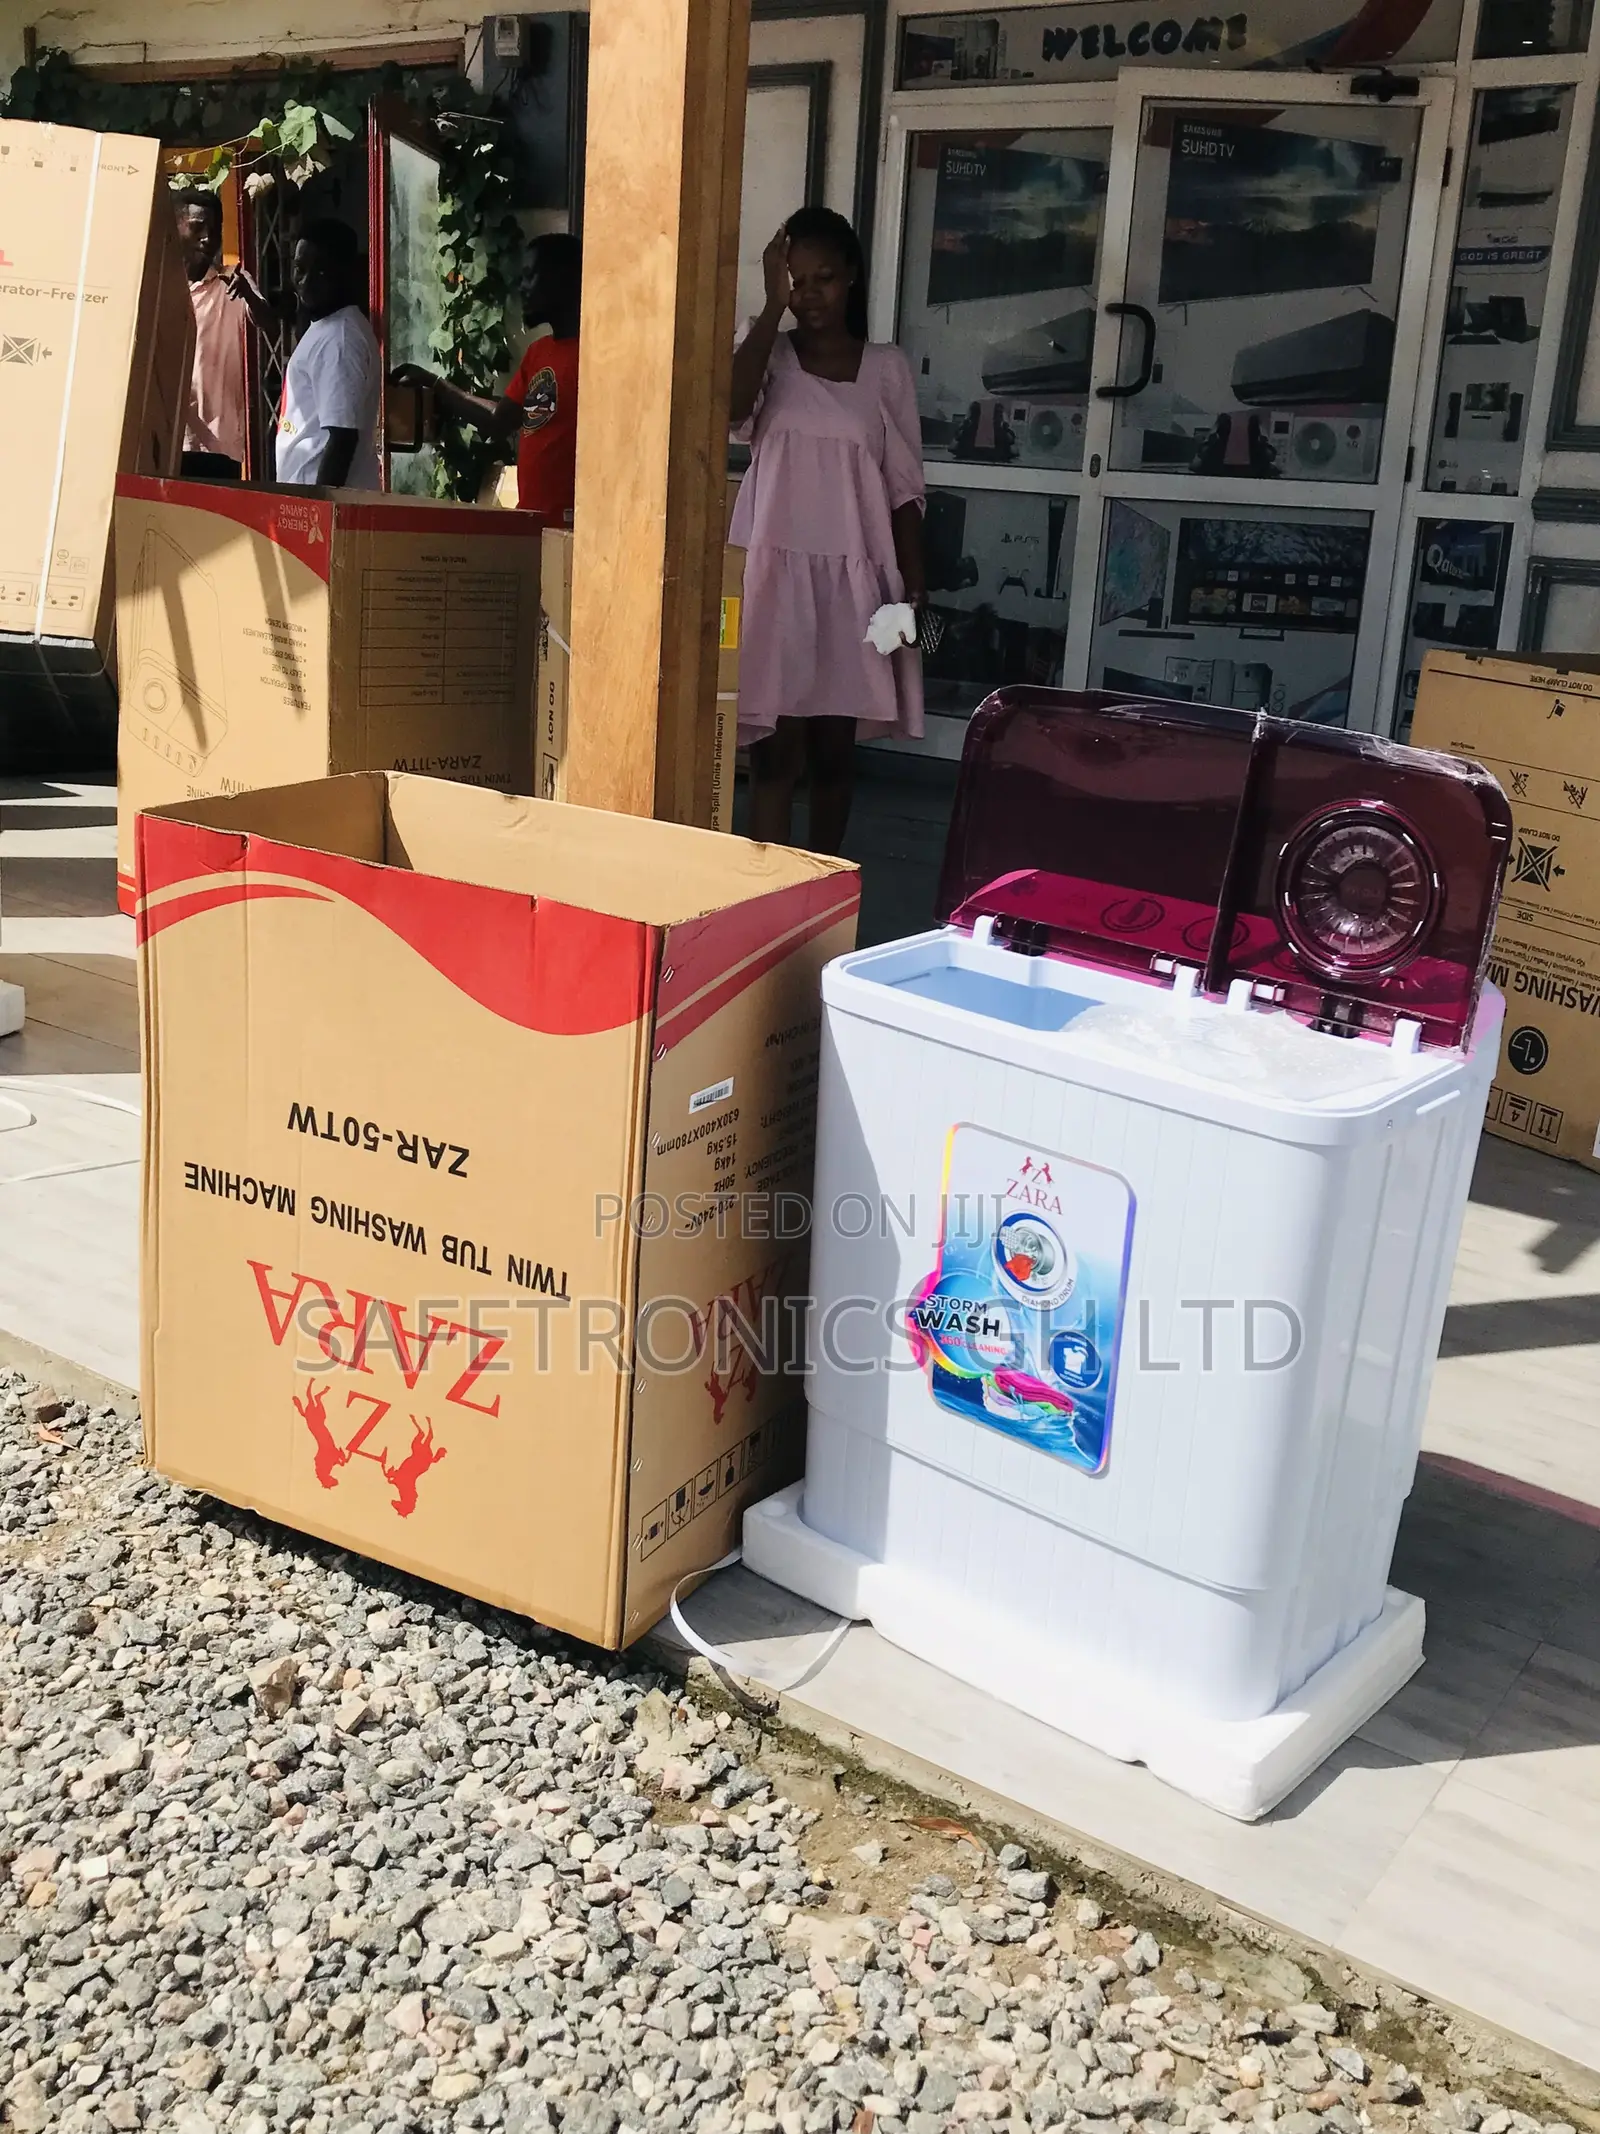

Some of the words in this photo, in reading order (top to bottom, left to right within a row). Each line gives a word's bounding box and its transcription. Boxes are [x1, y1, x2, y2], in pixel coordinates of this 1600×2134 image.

[1041, 13, 1248, 62] WELCOME
[279, 503, 309, 518] SAVING
[277, 516, 310, 532] ENERGY
[548, 681, 555, 705] DO
[1568, 681, 1582, 690] NOT
[1583, 684, 1593, 692] DO
[547, 709, 555, 746] NOT
[392, 755, 482, 771] ZARA-11TW
[485, 773, 511, 784] TWIN
[711, 791, 720, 813] Split
[1518, 827, 1538, 837] CLAMP
[1538, 831, 1551, 840] NOT
[1551, 834, 1561, 842] DO
[1516, 910, 1534, 922] SIDE
[287, 1101, 470, 1178] ZAR-50TW
[657, 1108, 740, 1156] 630X400X780mm
[706, 1132, 737, 1156] 15.5kg
[714, 1152, 736, 1171] 14kg
[183, 1161, 296, 1216] MACHINE
[713, 1173, 736, 1193] 50Hz
[1005, 1178, 1064, 1216] ZARA
[311, 1196, 428, 1255] WASHING
[441, 1234, 492, 1276] TUB
[508, 1254, 572, 1301] TWIN
[926, 1294, 987, 1315] STORM
[916, 1309, 1000, 1338] WASH
[246, 1260, 505, 1419] ZARA
